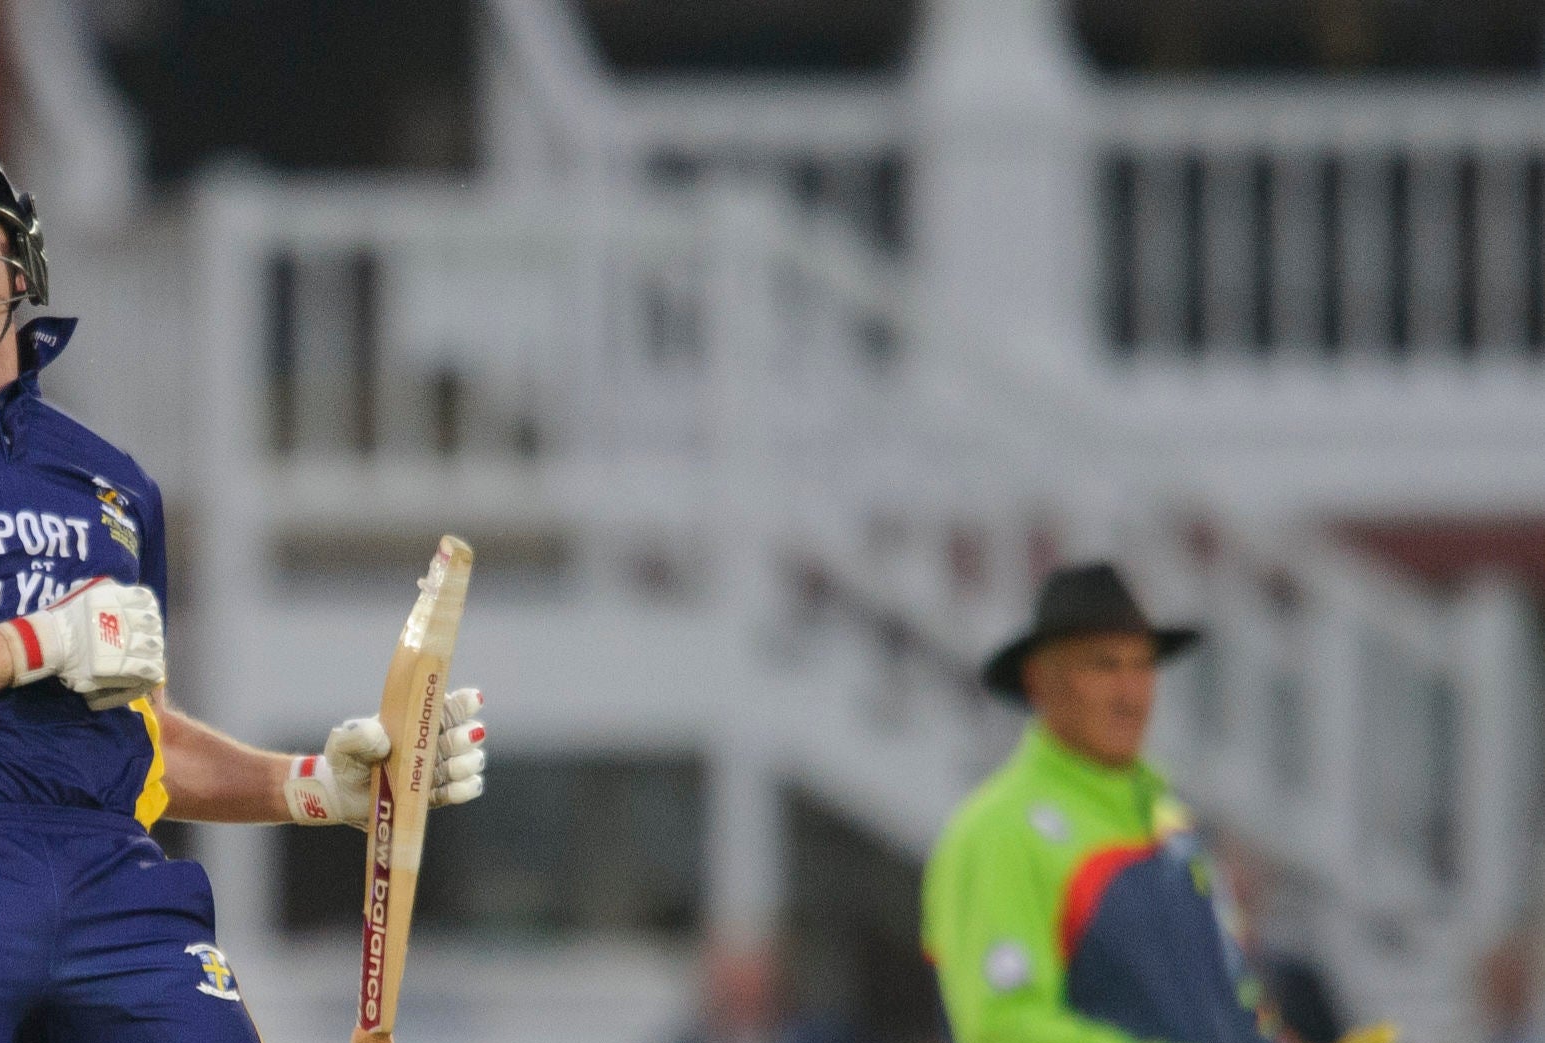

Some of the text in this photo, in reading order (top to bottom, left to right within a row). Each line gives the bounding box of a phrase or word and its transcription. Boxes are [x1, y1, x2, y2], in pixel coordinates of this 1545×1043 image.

[410, 673, 439, 793] new balance
[364, 799, 393, 1022] new balance
